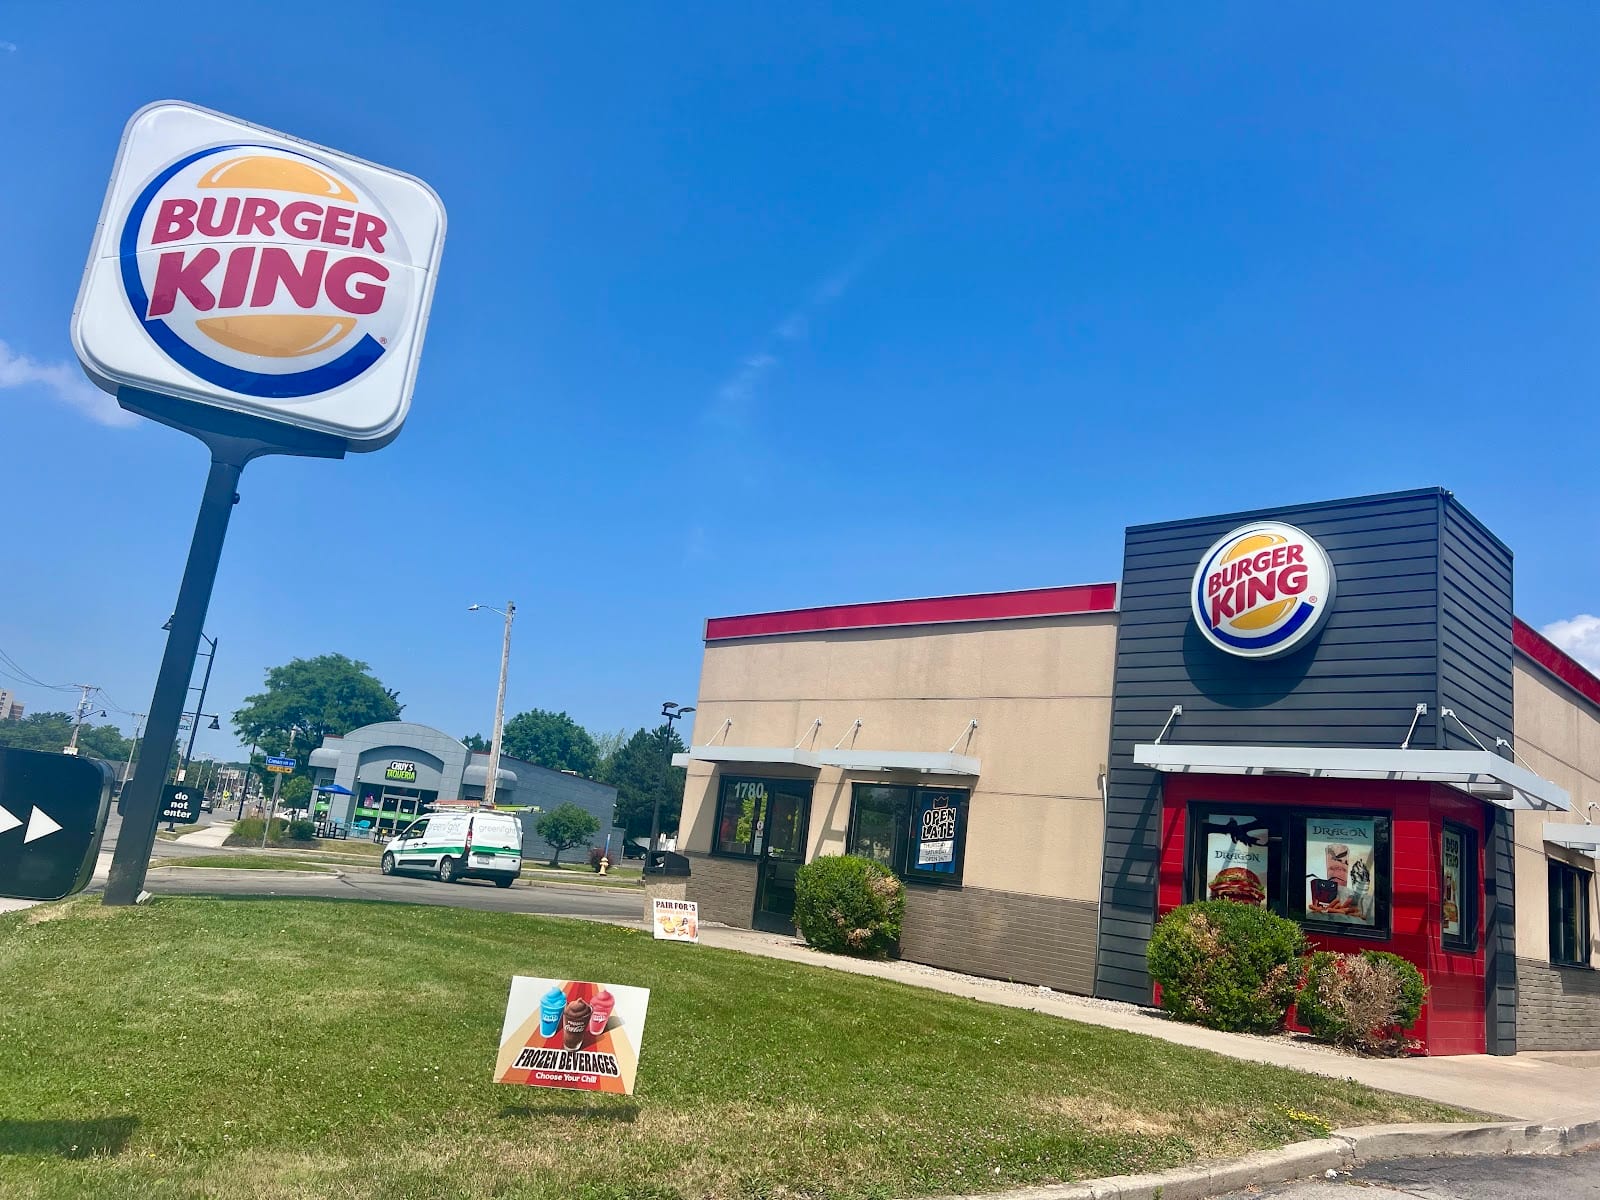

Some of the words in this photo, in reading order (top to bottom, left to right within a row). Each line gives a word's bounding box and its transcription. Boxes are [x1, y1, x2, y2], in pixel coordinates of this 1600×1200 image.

[151, 197, 388, 254] BURGER
[149, 247, 390, 317] KING
[1208, 544, 1304, 597] BURGER
[1212, 564, 1309, 628] KING
[386, 769, 415, 782] TAQUERIA
[174, 791, 189, 801] do
[734, 782, 764, 799] 1780
[170, 801, 189, 810] not
[163, 809, 192, 819] enter
[923, 808, 956, 826] OPEN
[921, 823, 954, 840] LATE
[1312, 825, 1369, 839] DRAGON
[1215, 850, 1261, 863] DRAGON
[656, 901, 673, 909] PAIR
[674, 902, 688, 911] FOR
[514, 1048, 559, 1070] FROZEN
[559, 1051, 618, 1076] BEVERAGES
[535, 1072, 562, 1081] Choose
[564, 1074, 580, 1082] Your
[581, 1075, 597, 1083] Chill
